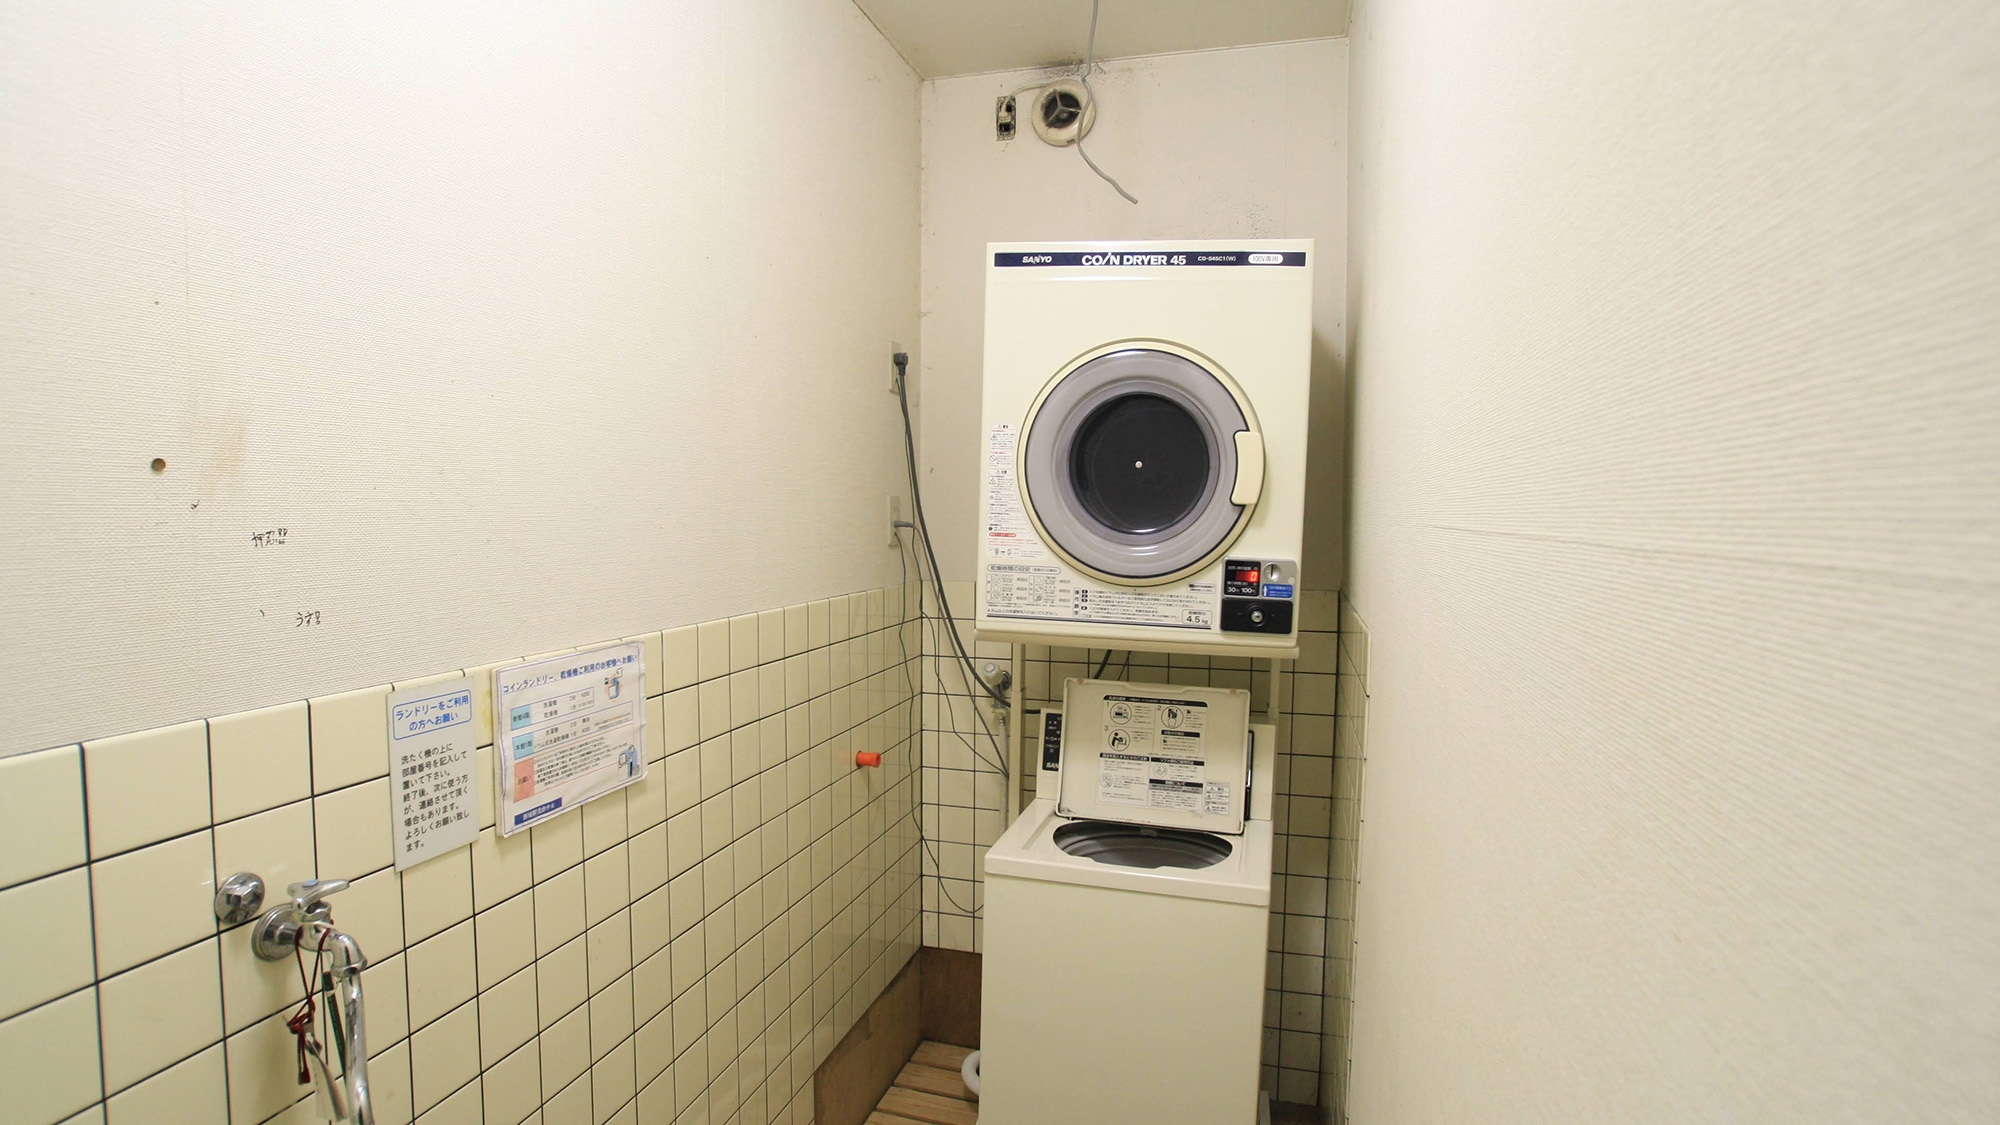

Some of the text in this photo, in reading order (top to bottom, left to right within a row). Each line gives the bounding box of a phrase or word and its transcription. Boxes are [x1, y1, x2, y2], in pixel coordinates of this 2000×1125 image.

[1022, 256, 1052, 264] SANYO
[1123, 255, 1167, 266] DRYER
[1170, 255, 1187, 265] 45
[1250, 571, 1258, 581] 0
[395, 694, 470, 721] ランドリーをご利用
[408, 711, 459, 732] の方へお願い
[401, 743, 453, 765] 洗たく機の上に
[402, 751, 467, 778] 部屋番号を記入して
[402, 769, 451, 790] 置いて下さい。
[402, 774, 469, 803] 終了後、次に使う方
[403, 785, 469, 815] が、連絡させて頂く
[404, 802, 460, 827] 場合もあります。
[405, 809, 470, 840] よろしくお願い致し
[406, 840, 424, 853] ます。
